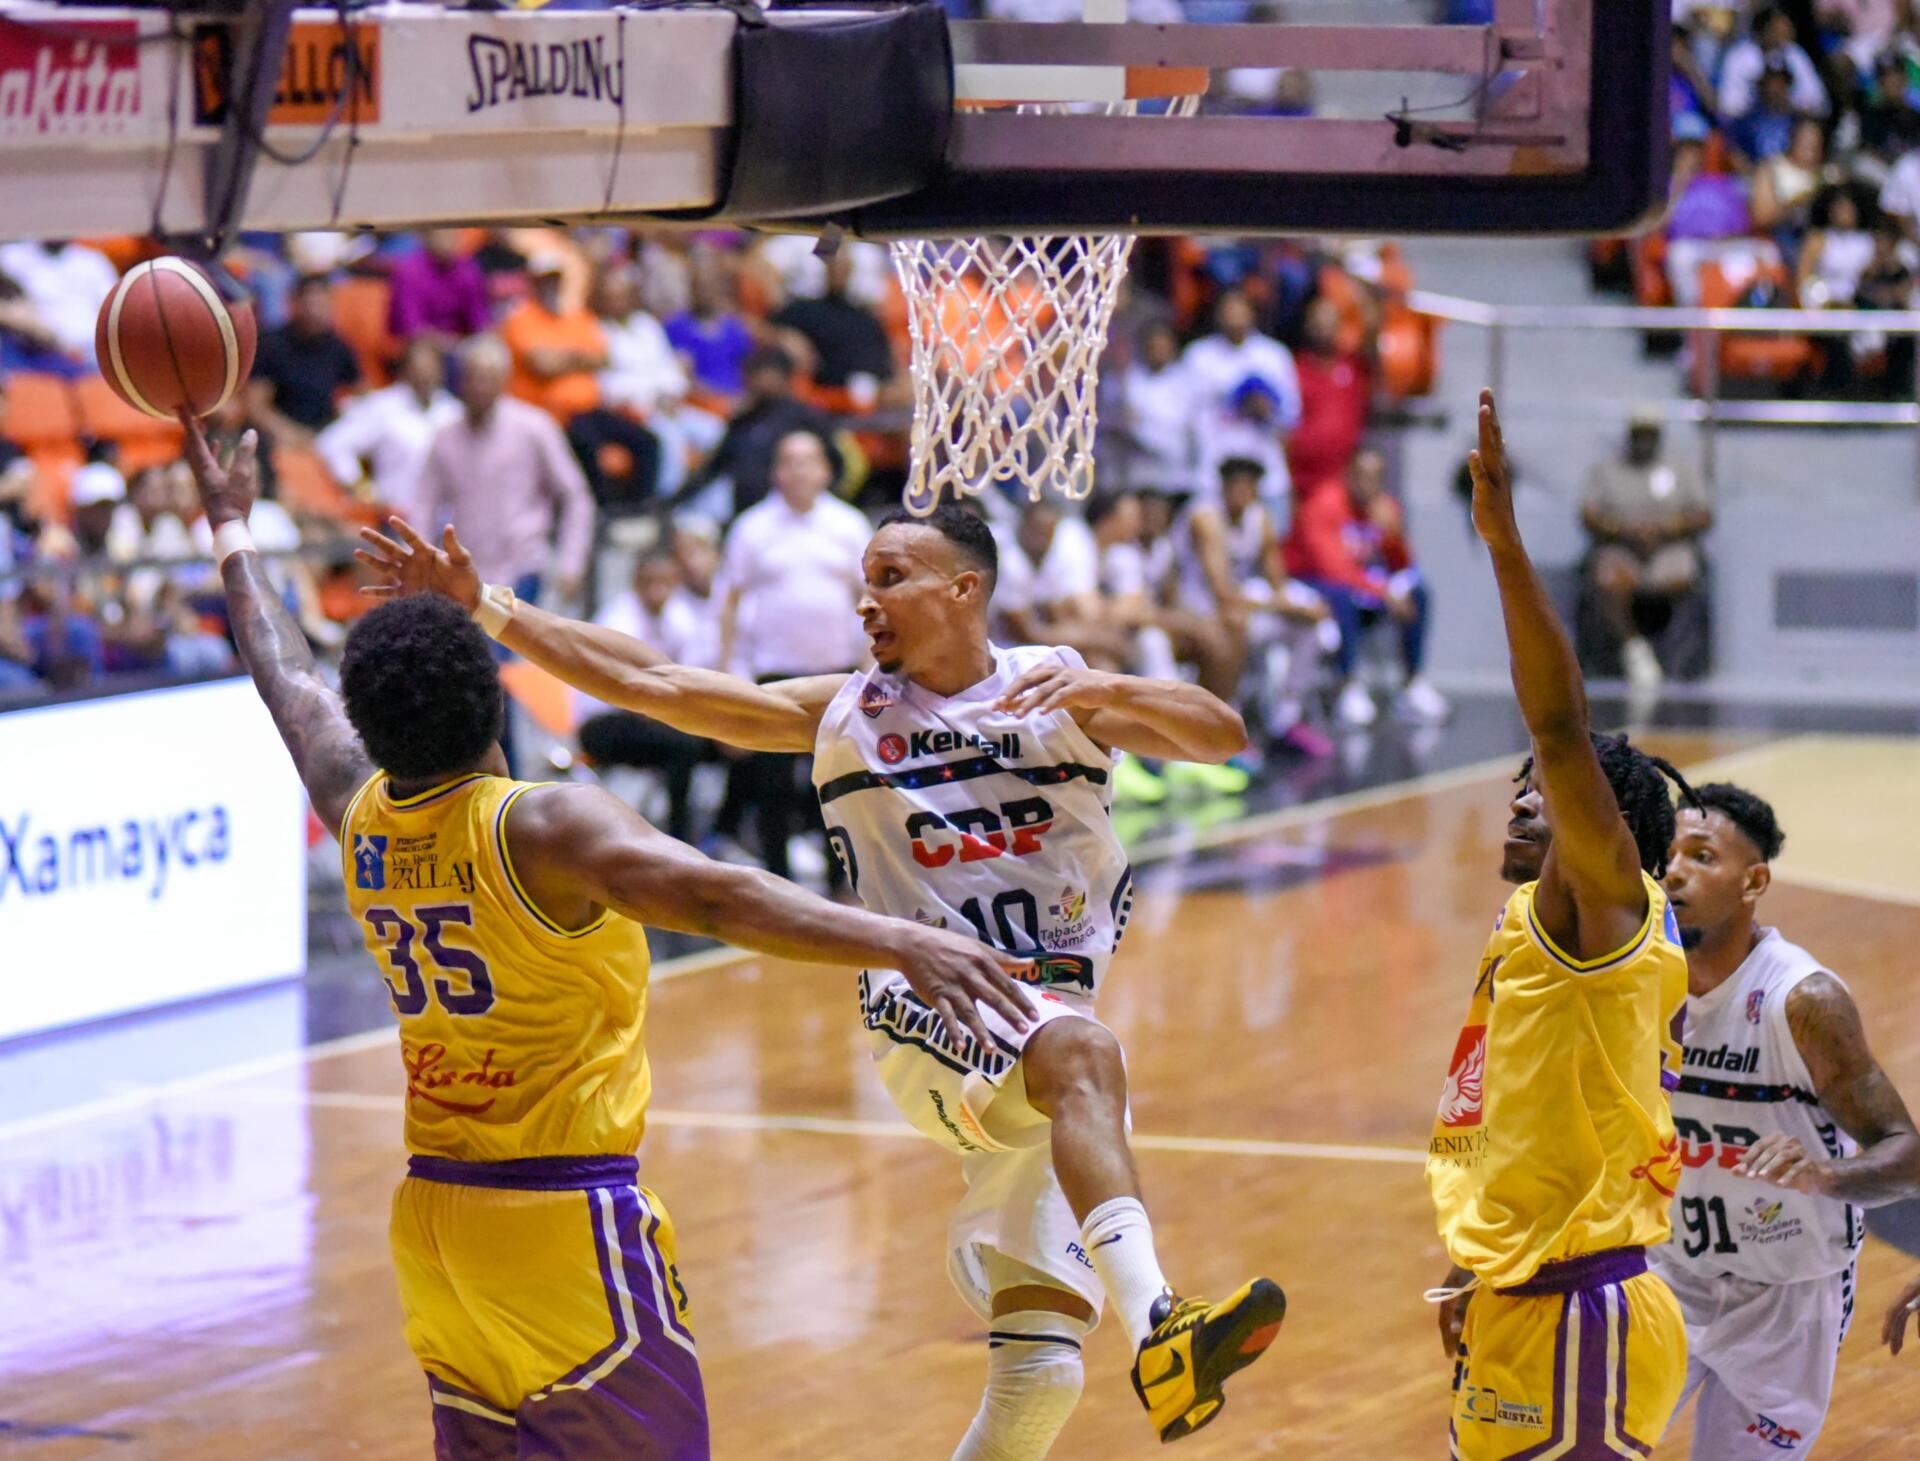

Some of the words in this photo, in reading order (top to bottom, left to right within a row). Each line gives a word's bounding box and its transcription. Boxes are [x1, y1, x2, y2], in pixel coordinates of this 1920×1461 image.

[364, 904, 496, 1016] 35
[1681, 1195, 1738, 1258] 91
[1497, 1409, 1543, 1425] CRISTAL
